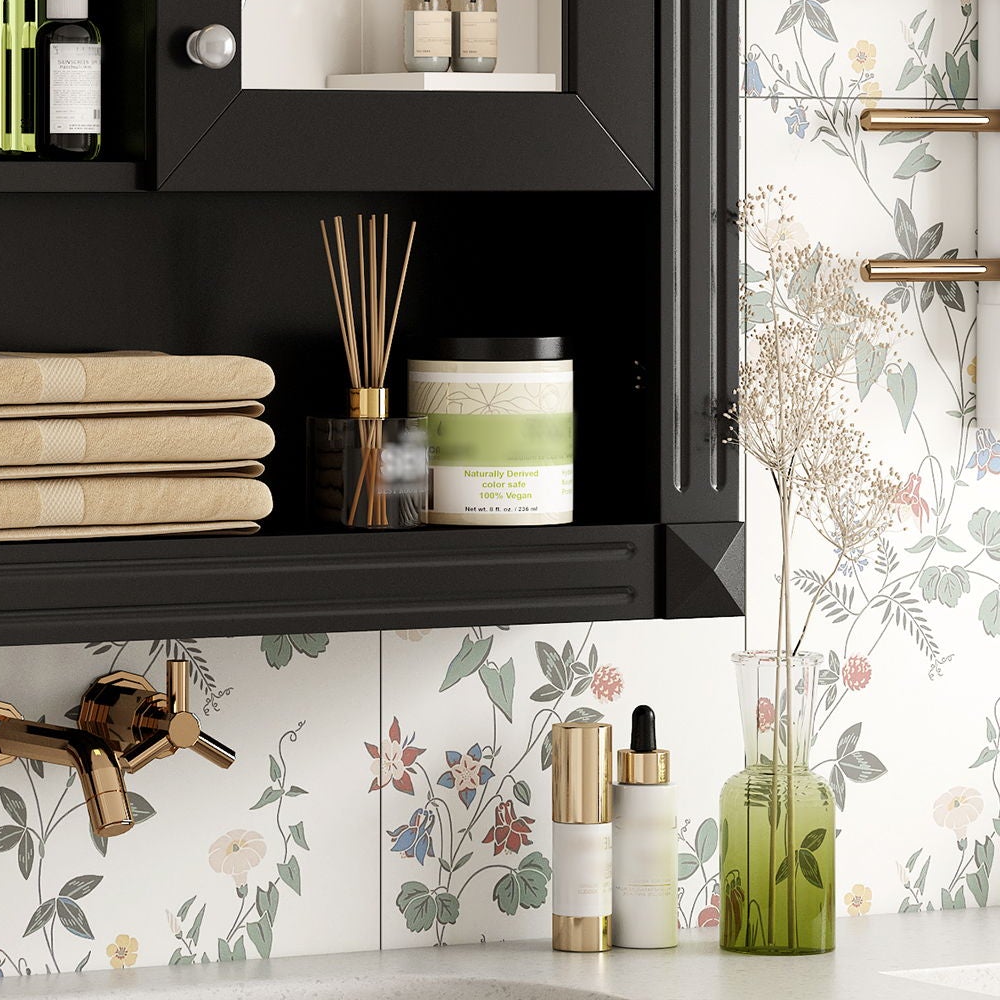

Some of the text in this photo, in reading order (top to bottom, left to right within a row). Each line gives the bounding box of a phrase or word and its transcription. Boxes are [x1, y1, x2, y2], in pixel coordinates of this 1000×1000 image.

[464, 470, 539, 479] Naturally Derived
[506, 492, 532, 500] Vegan
